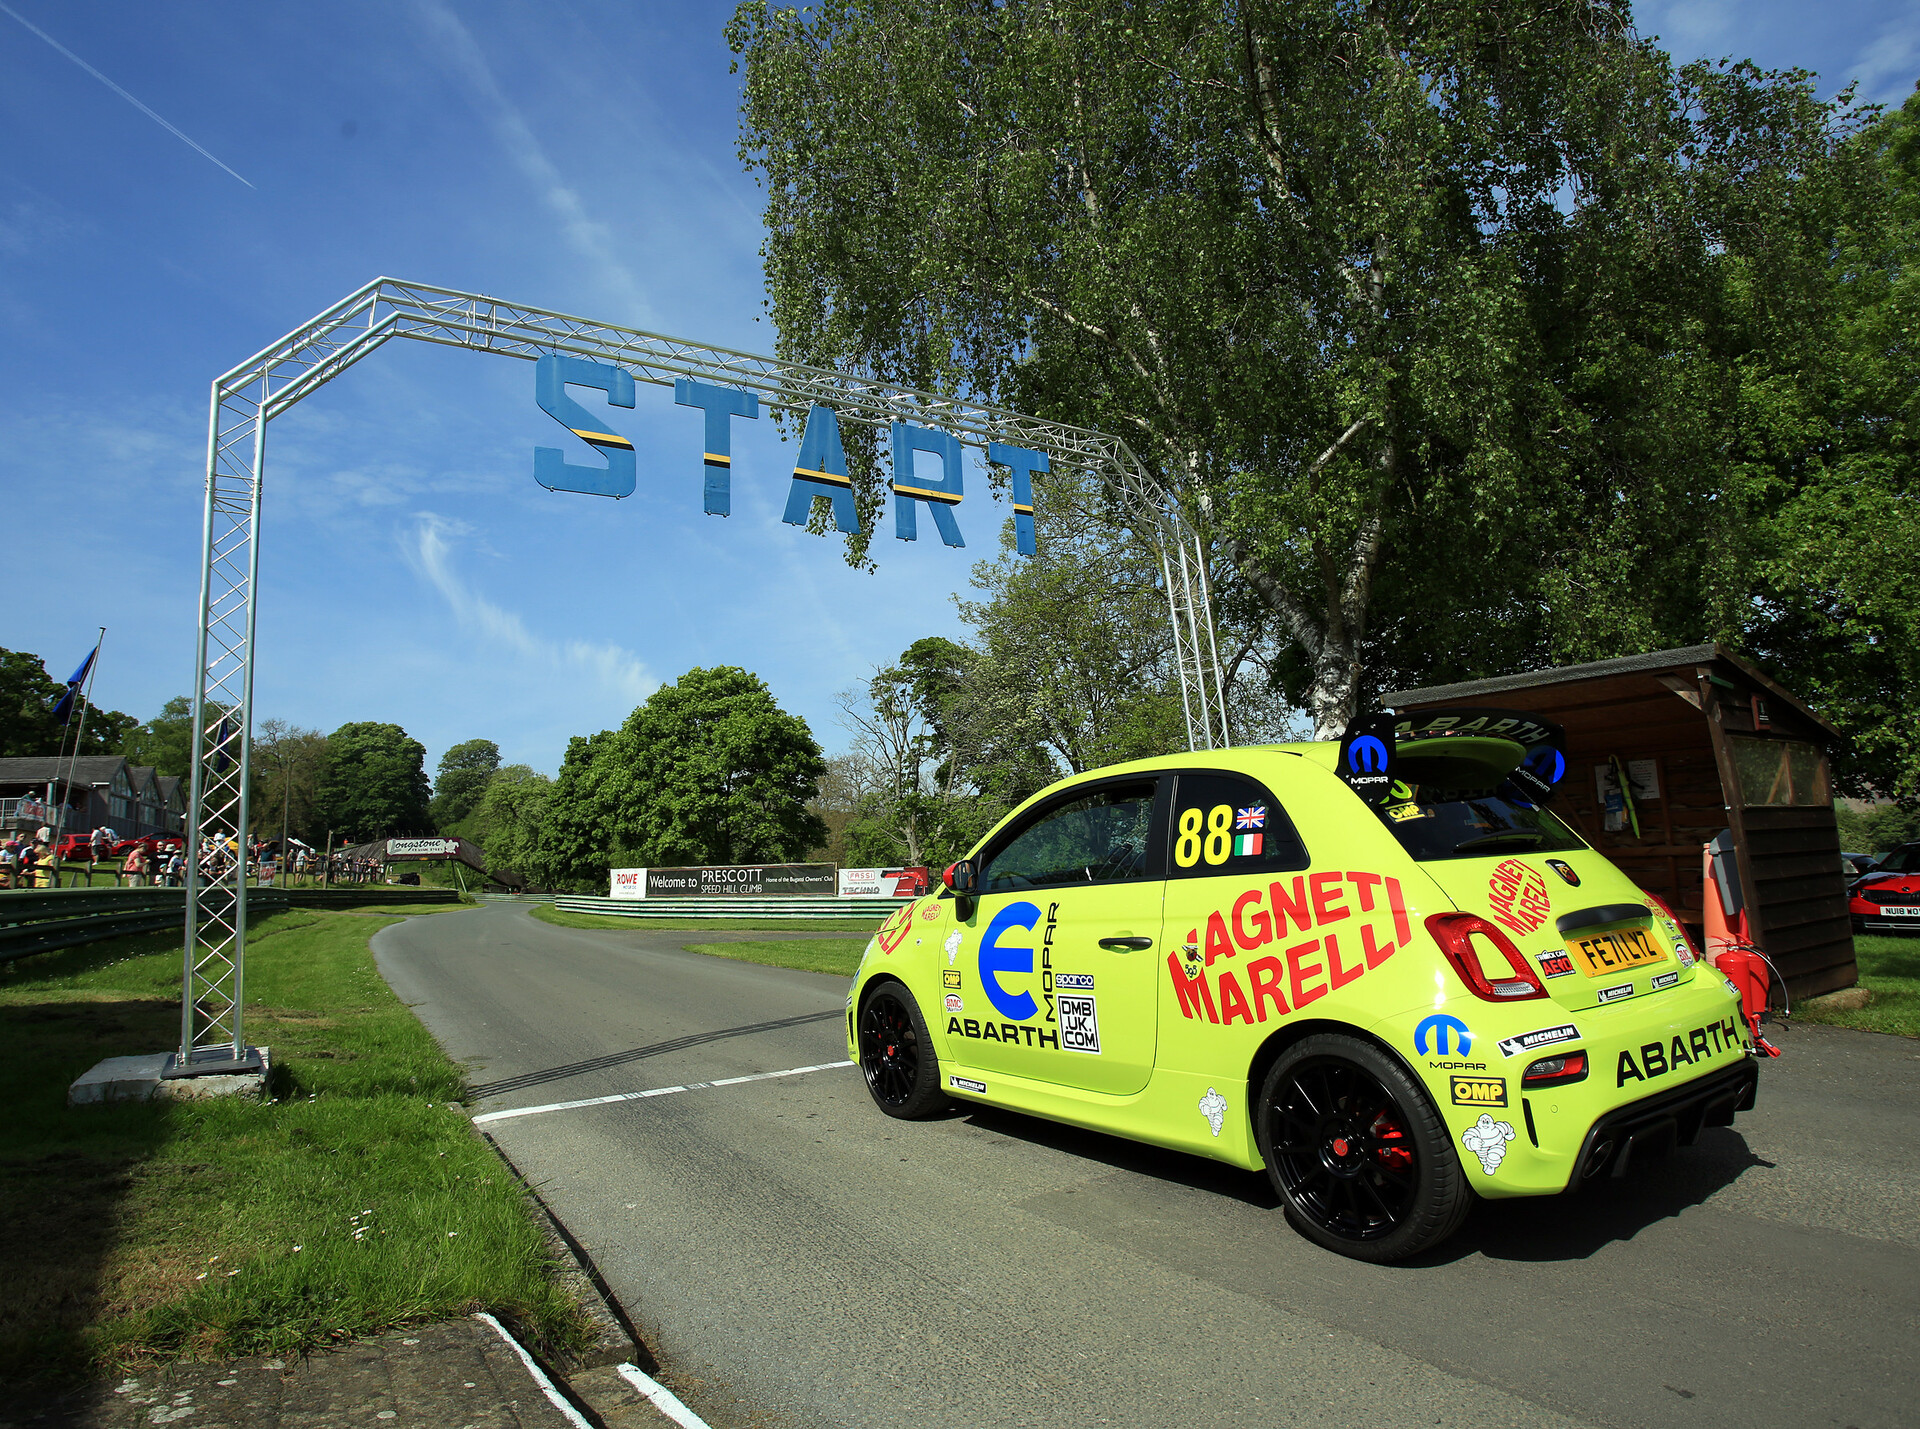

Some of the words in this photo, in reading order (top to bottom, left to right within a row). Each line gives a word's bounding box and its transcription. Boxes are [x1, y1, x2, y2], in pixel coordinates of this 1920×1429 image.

[533, 353, 1050, 556] START
[1350, 776, 1388, 784] MOPAR
[1516, 766, 1551, 793] MOPAR
[1388, 805, 1420, 819] OMP
[1174, 804, 1233, 868] 88
[616, 873, 638, 884] ROWE
[649, 875, 686, 888] Welcome
[688, 878, 698, 888] to
[701, 868, 763, 882] PRESCOTT
[700, 884, 721, 894] SPEED
[722, 884, 738, 894] HILL
[739, 883, 763, 894] CLIMB
[843, 886, 880, 895] TECHNO
[1042, 902, 1060, 1023] MOPAR
[944, 975, 960, 986] OMP
[1055, 974, 1094, 989] sparco
[1607, 985, 1632, 998] MICHELIN
[945, 998, 962, 1008] BMC
[1061, 1001, 1092, 1017] DMB
[947, 1016, 1059, 1050] ABARTH
[1065, 1031, 1096, 1048] COM
[1523, 1027, 1575, 1046] MICHELIN
[1616, 1015, 1740, 1088] ABARTH
[1429, 1061, 1487, 1071] MOPAR
[957, 1079, 985, 1091] MICHELIN
[1454, 1083, 1503, 1101] OMP
